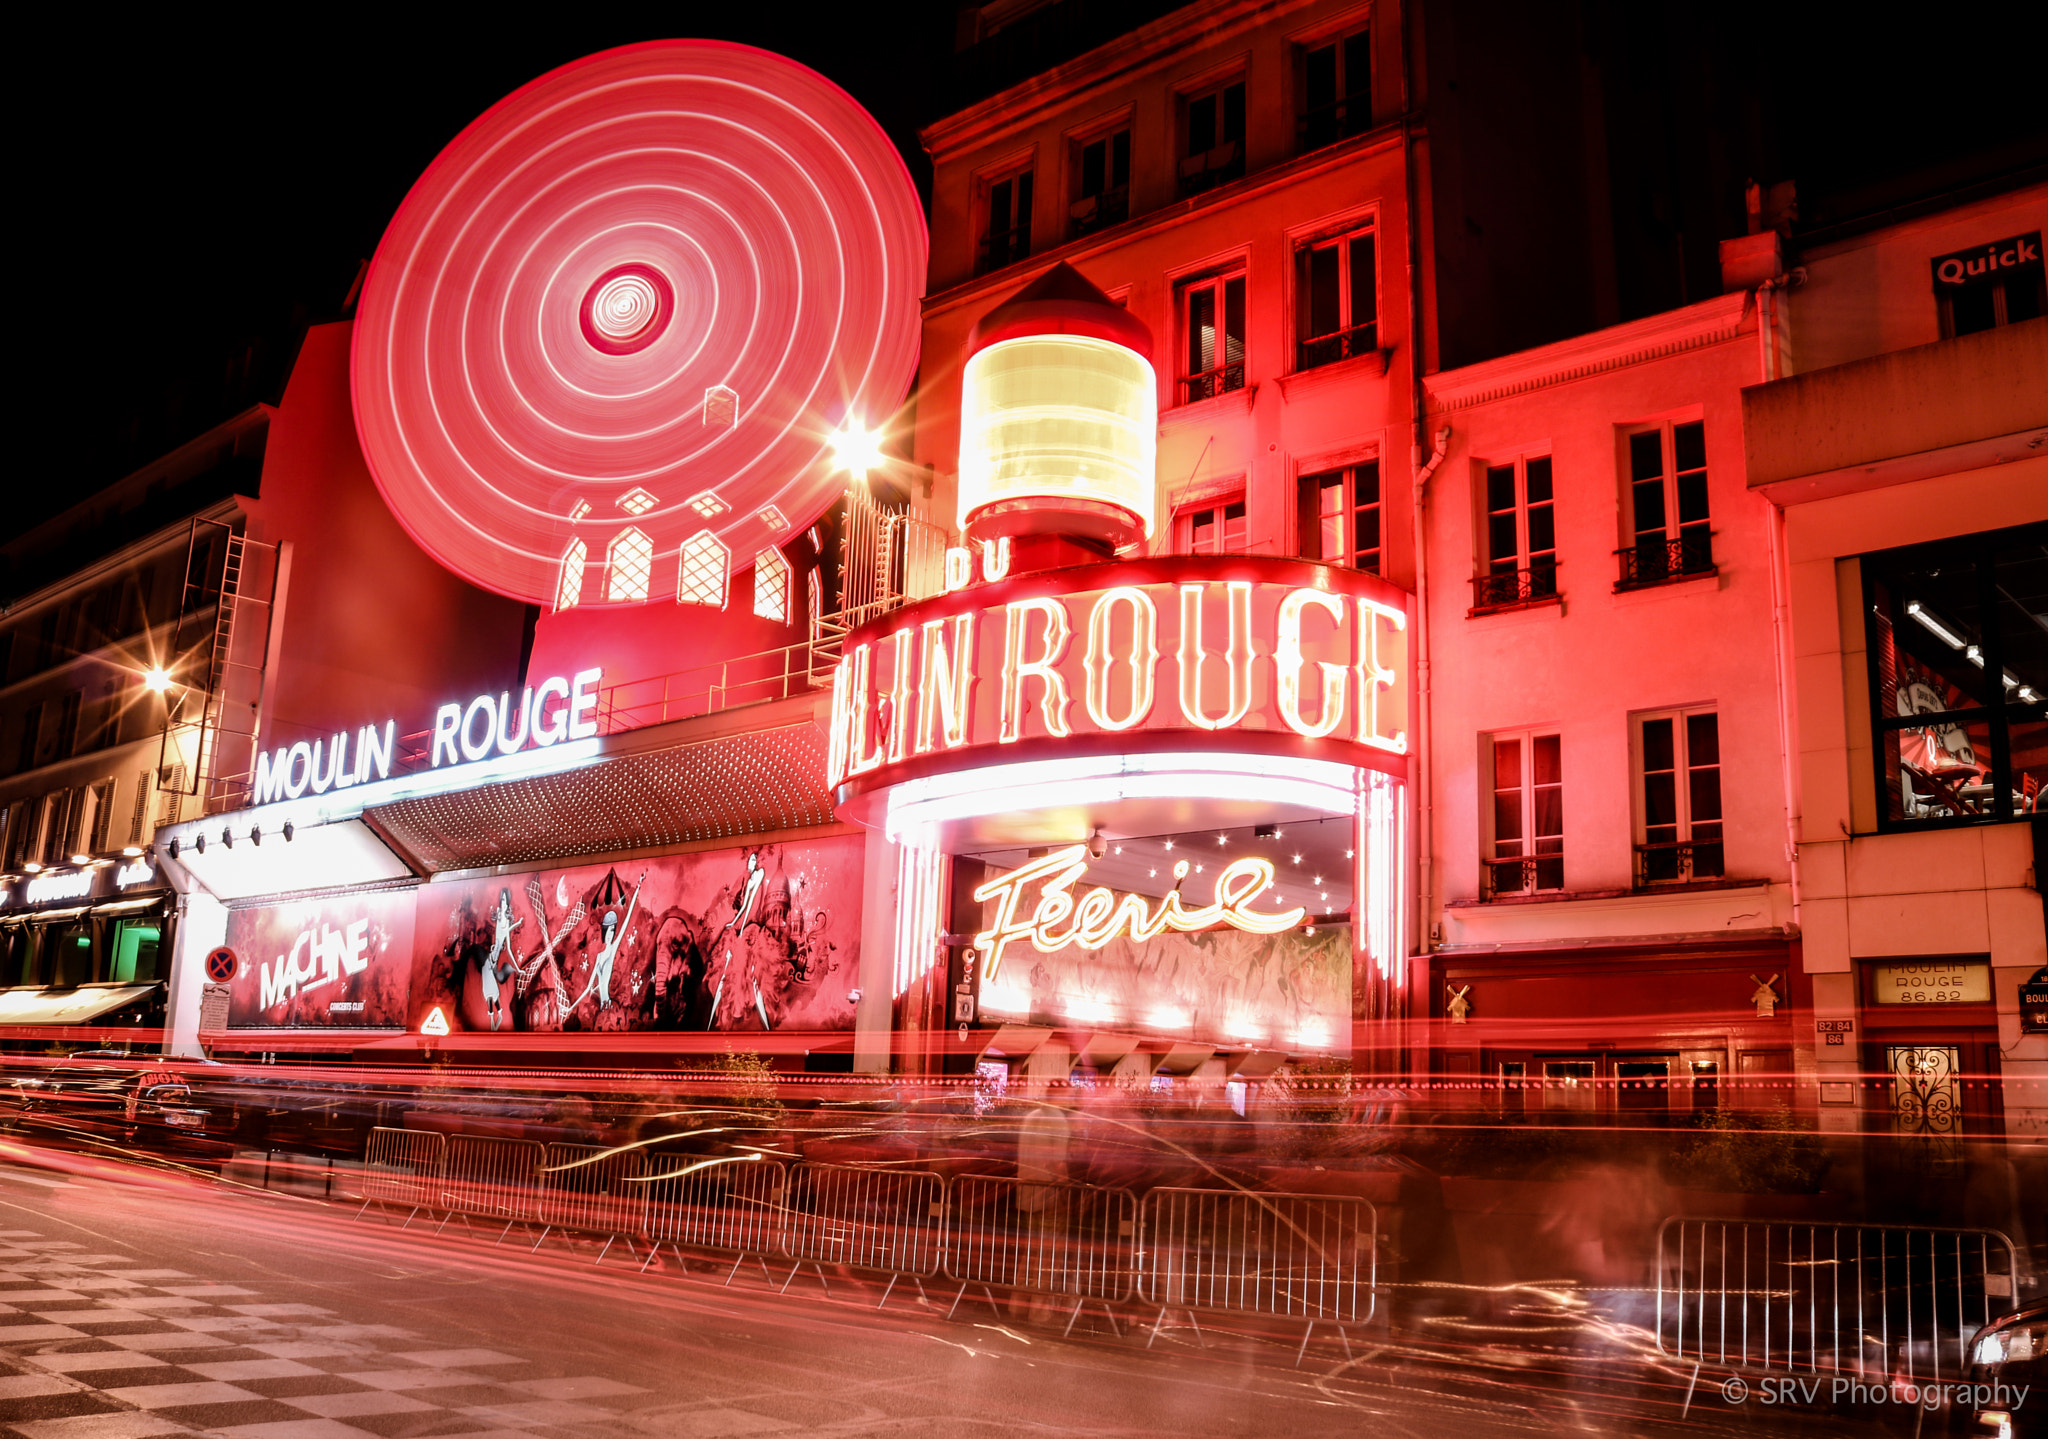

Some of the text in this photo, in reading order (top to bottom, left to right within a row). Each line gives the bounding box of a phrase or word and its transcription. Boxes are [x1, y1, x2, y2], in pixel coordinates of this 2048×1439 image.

[1937, 239, 2039, 284] Quick
[945, 537, 1009, 588] DU
[1000, 581, 1407, 755] ROUGE
[252, 666, 602, 805] MOULIN ROUGE
[973, 843, 1306, 983] Féerie
[259, 917, 369, 1013] MACHINE
[1888, 962, 1967, 974] MOULIN
[1896, 976, 1963, 988] ROUGE
[1901, 991, 1961, 1002] 86.82
[1818, 1022, 1833, 1031] 82
[1828, 1035, 1841, 1044] 86
[1837, 1022, 1850, 1031] 84
